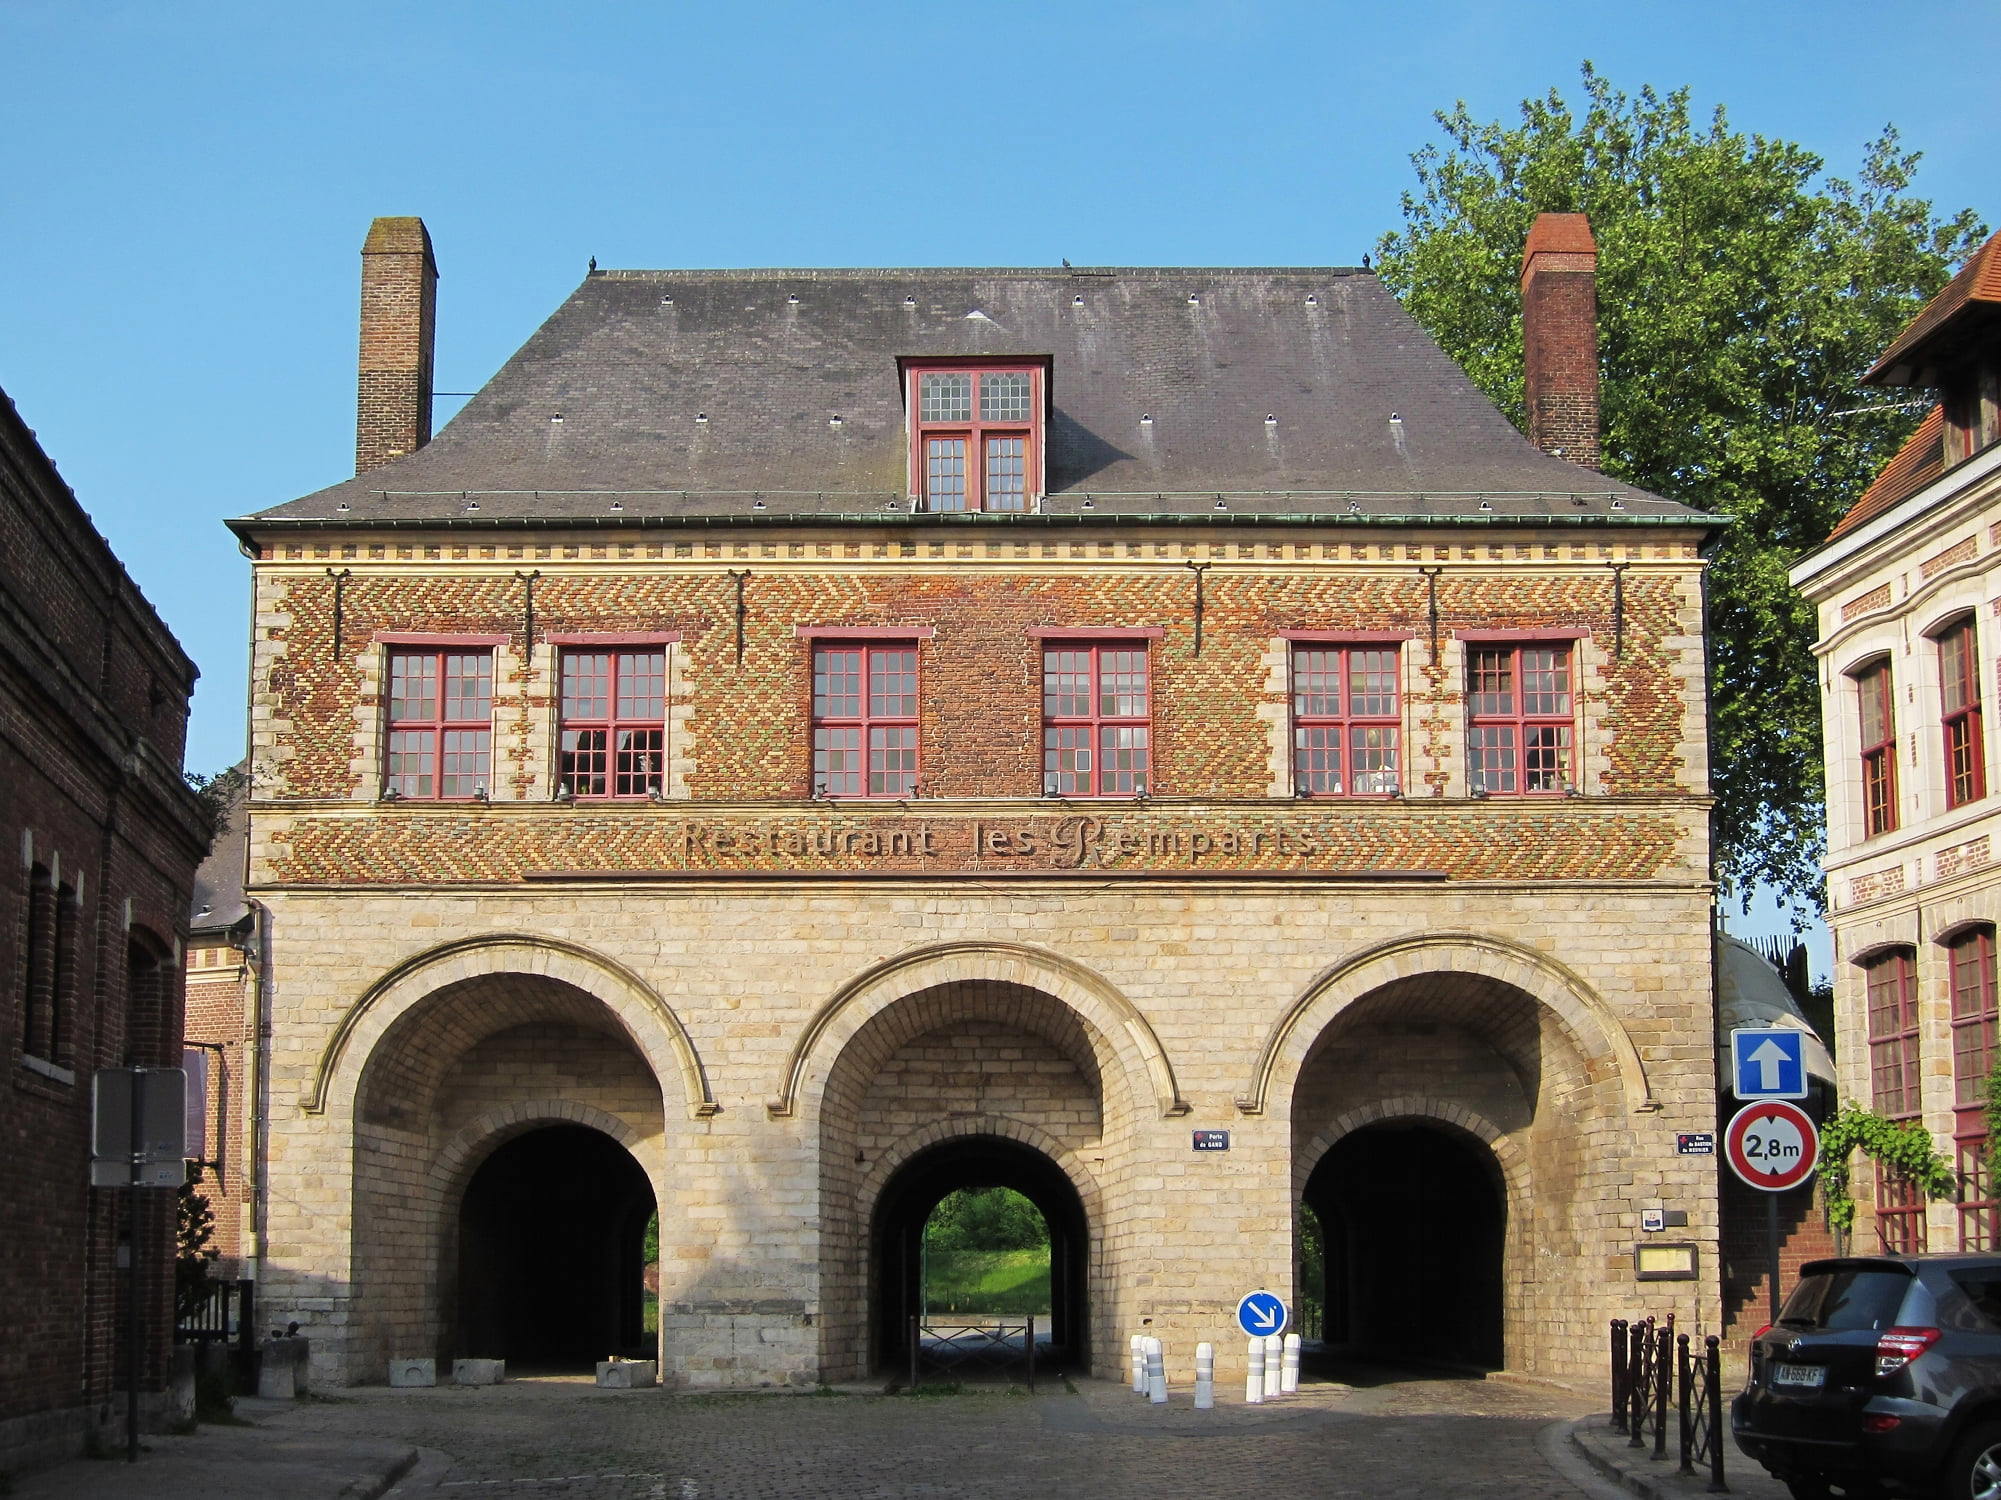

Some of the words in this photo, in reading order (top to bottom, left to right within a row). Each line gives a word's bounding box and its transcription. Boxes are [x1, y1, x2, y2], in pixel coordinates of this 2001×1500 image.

[682, 820, 935, 855] Restaurant
[972, 820, 1034, 854] les
[1050, 815, 1314, 868] Remparts
